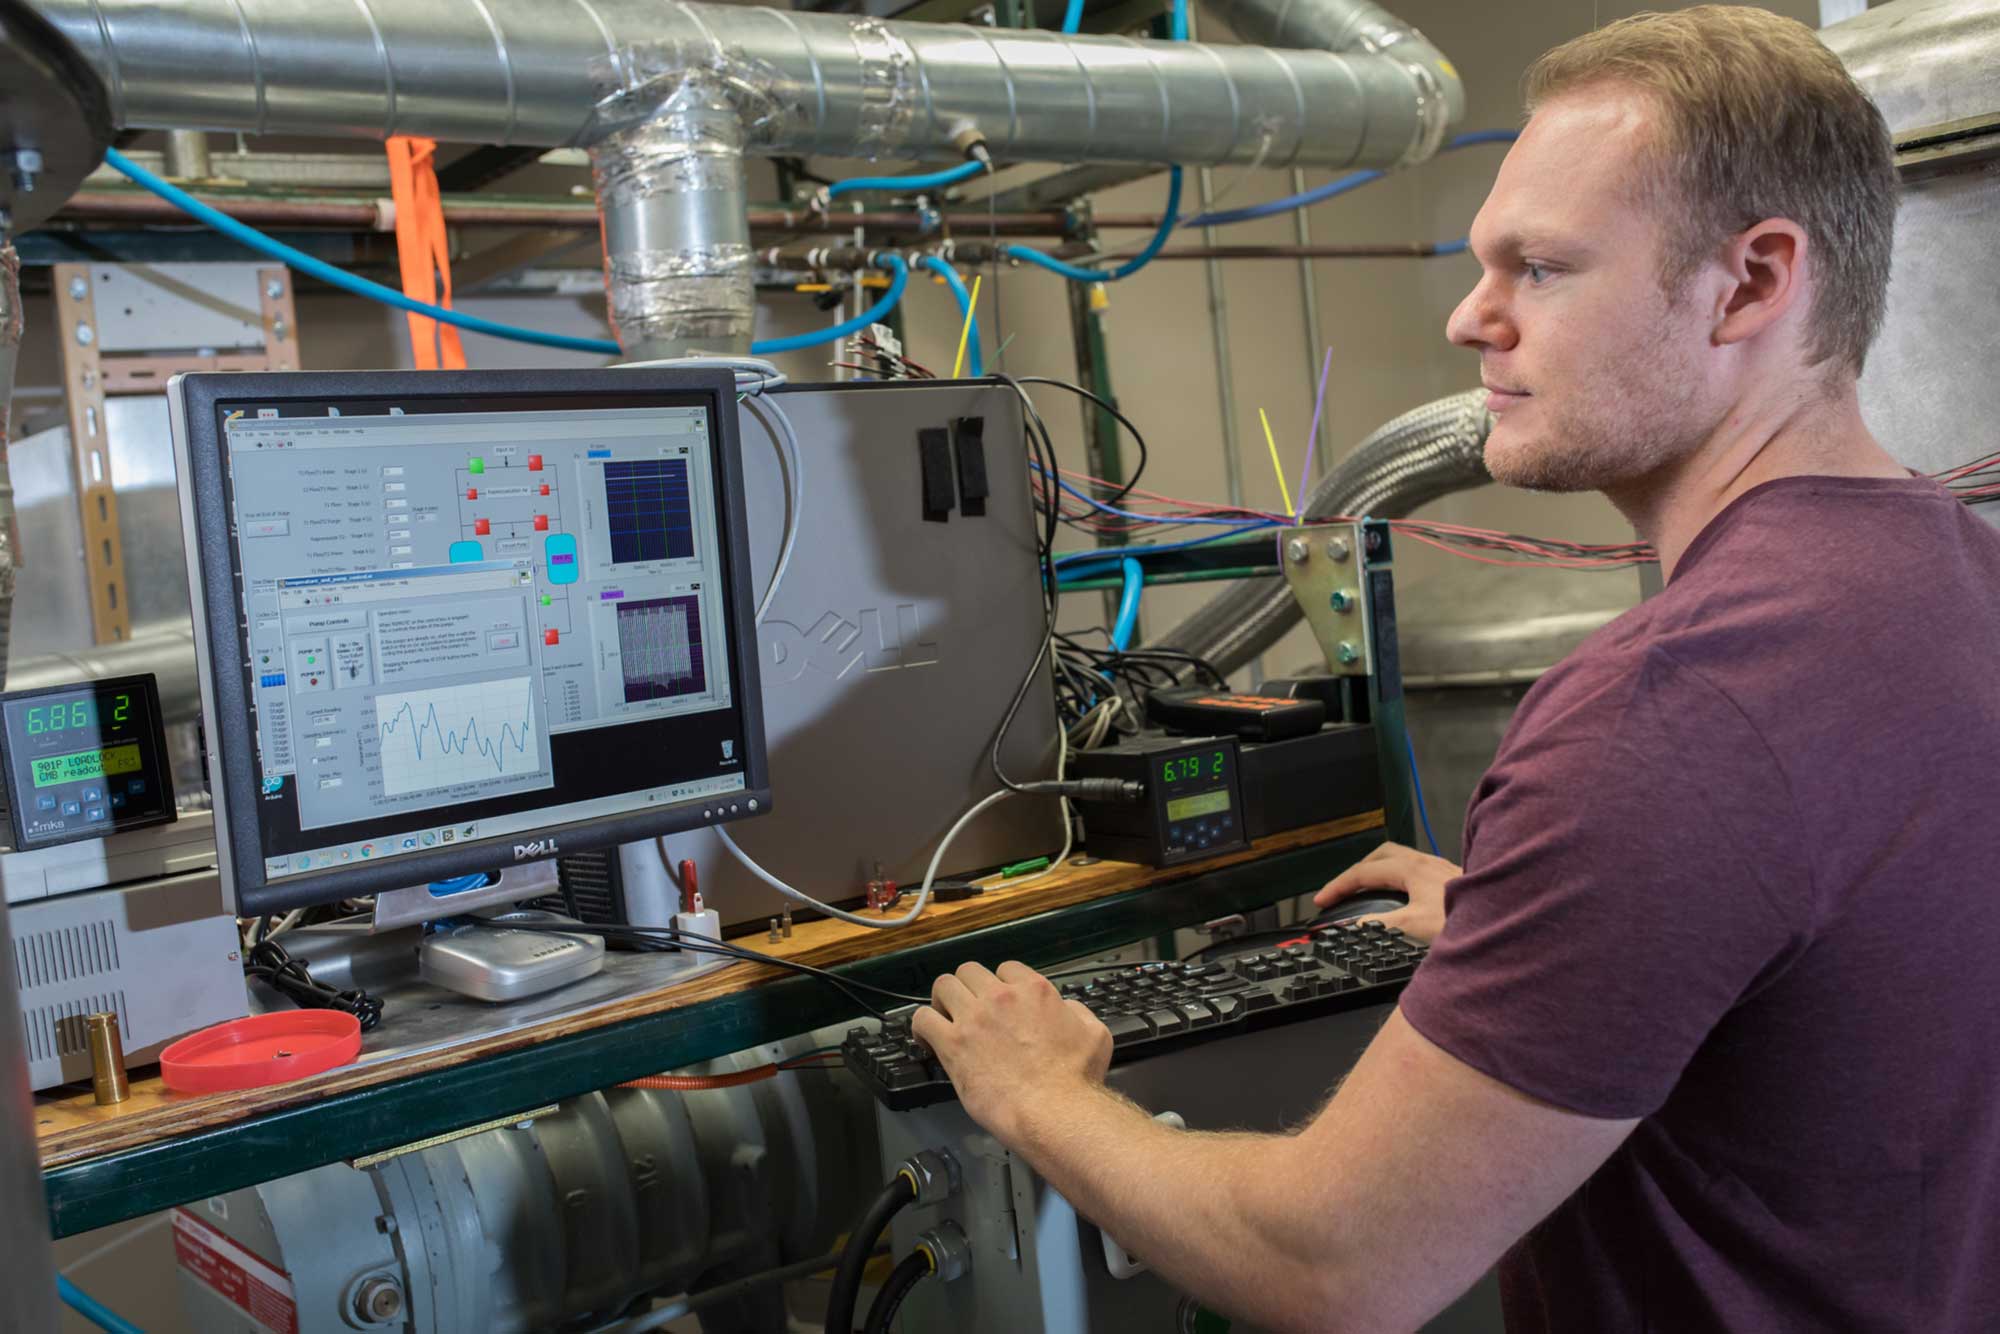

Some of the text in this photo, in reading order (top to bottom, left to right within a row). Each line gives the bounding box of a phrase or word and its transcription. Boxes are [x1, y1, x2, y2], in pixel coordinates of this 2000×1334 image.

[309, 617, 350, 629] Pump Controls
[759, 604, 940, 684] DELL
[27, 695, 130, 736] 6.86 2
[37, 751, 116, 774] 901P LOADLOCK
[64, 763, 105, 777] readout
[1164, 752, 1223, 782] 6.79 2
[39, 820, 65, 831] mks
[513, 838, 559, 860] DELL
